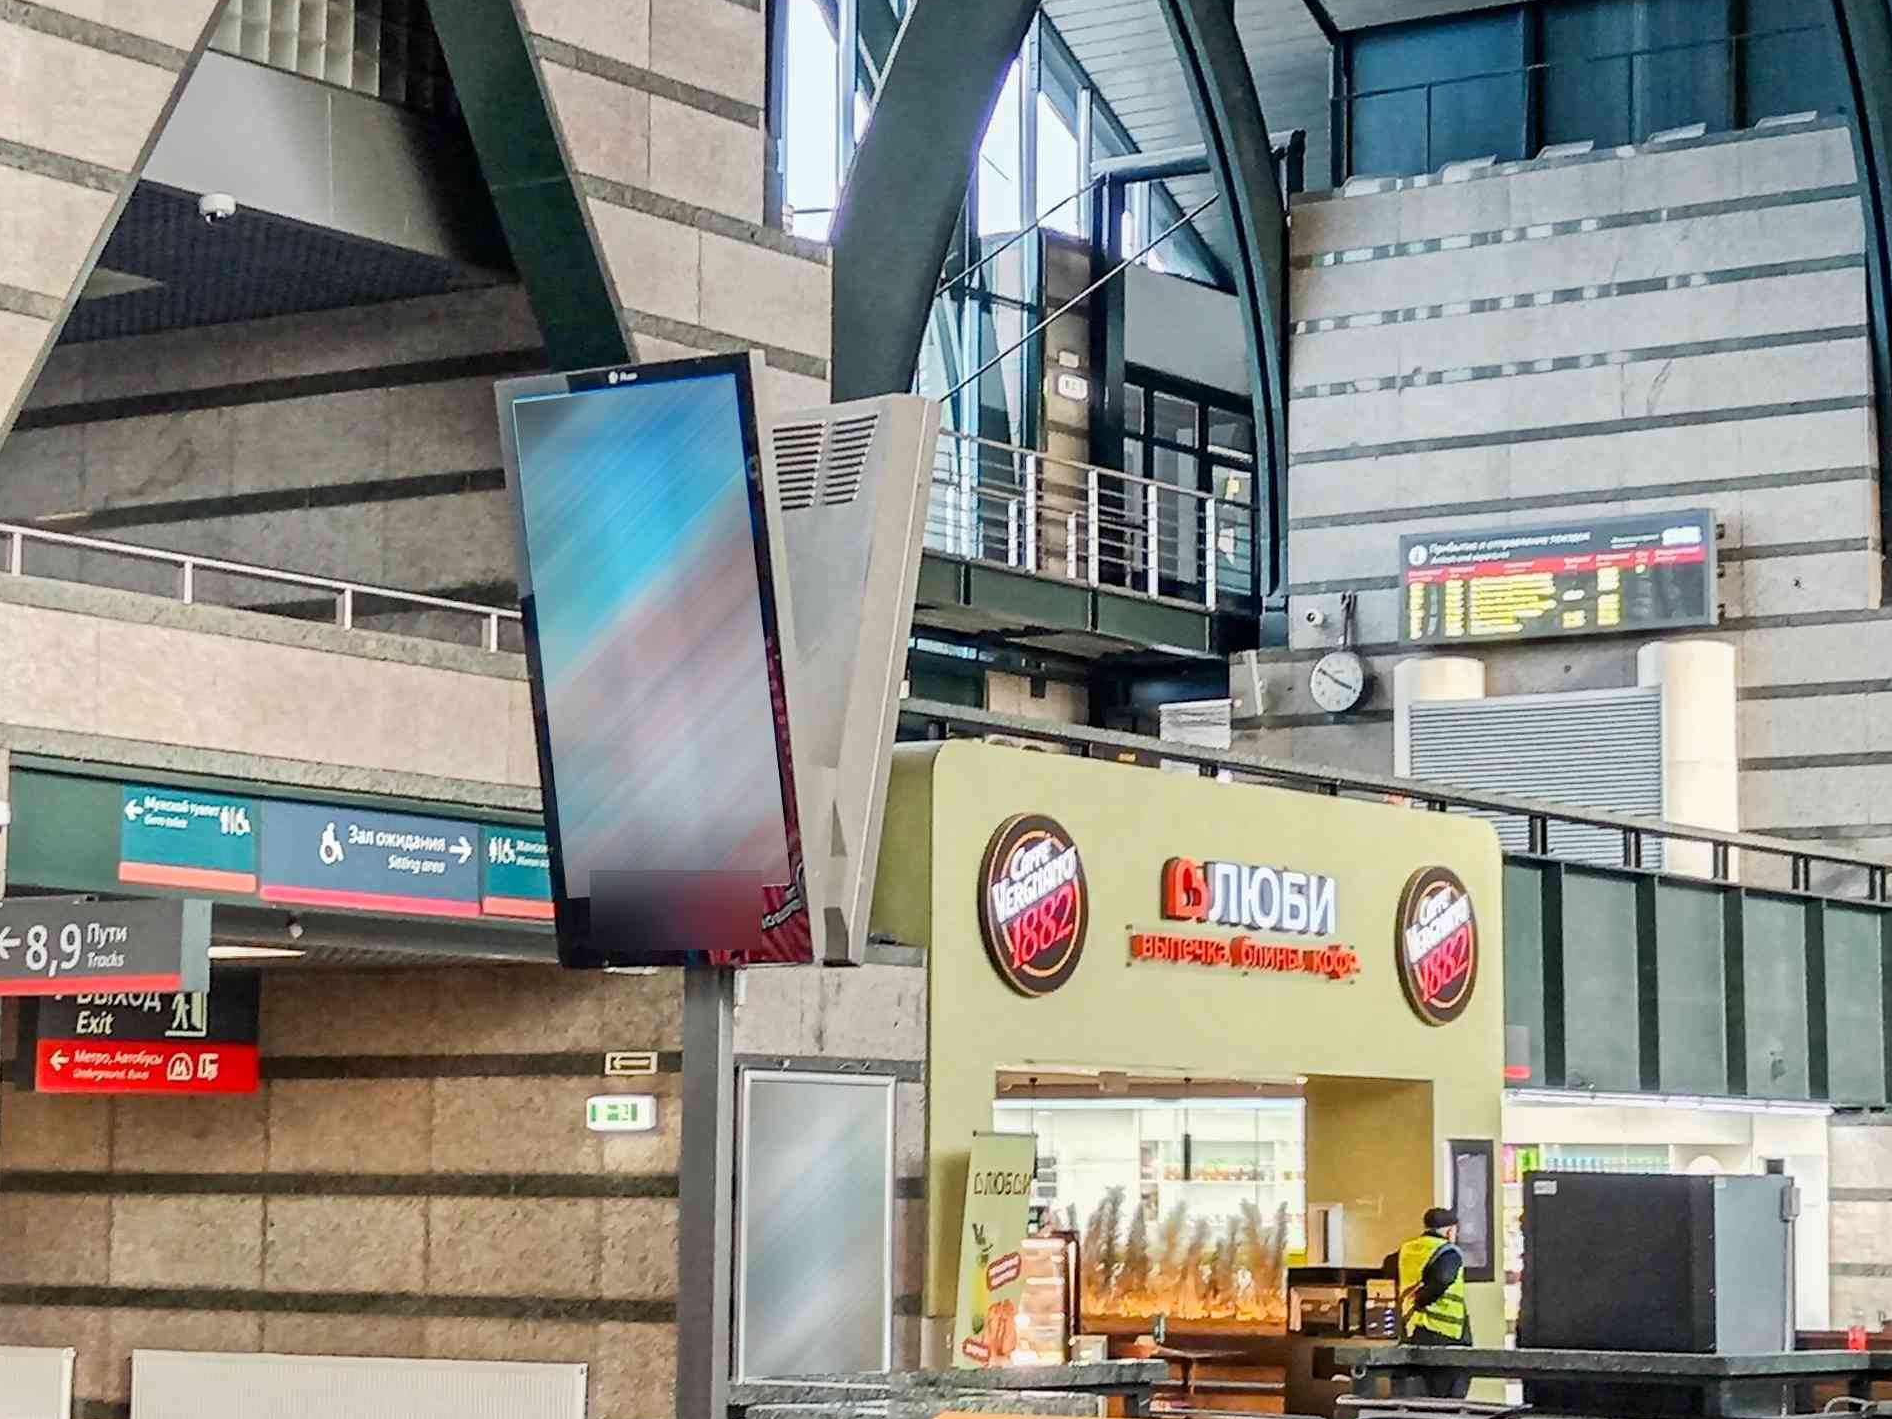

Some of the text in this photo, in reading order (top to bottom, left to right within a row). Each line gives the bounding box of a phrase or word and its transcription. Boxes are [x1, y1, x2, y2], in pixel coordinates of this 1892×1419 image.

[348, 825, 446, 853] Зал ожидания
[992, 845, 1078, 924] VERGNANO
[25, 922, 129, 978] 8,9 Пути
[1009, 883, 1075, 969] 1882
[87, 952, 126, 969] Tracks
[1421, 924, 1469, 1002] 1882
[75, 1010, 116, 1035] Exit
